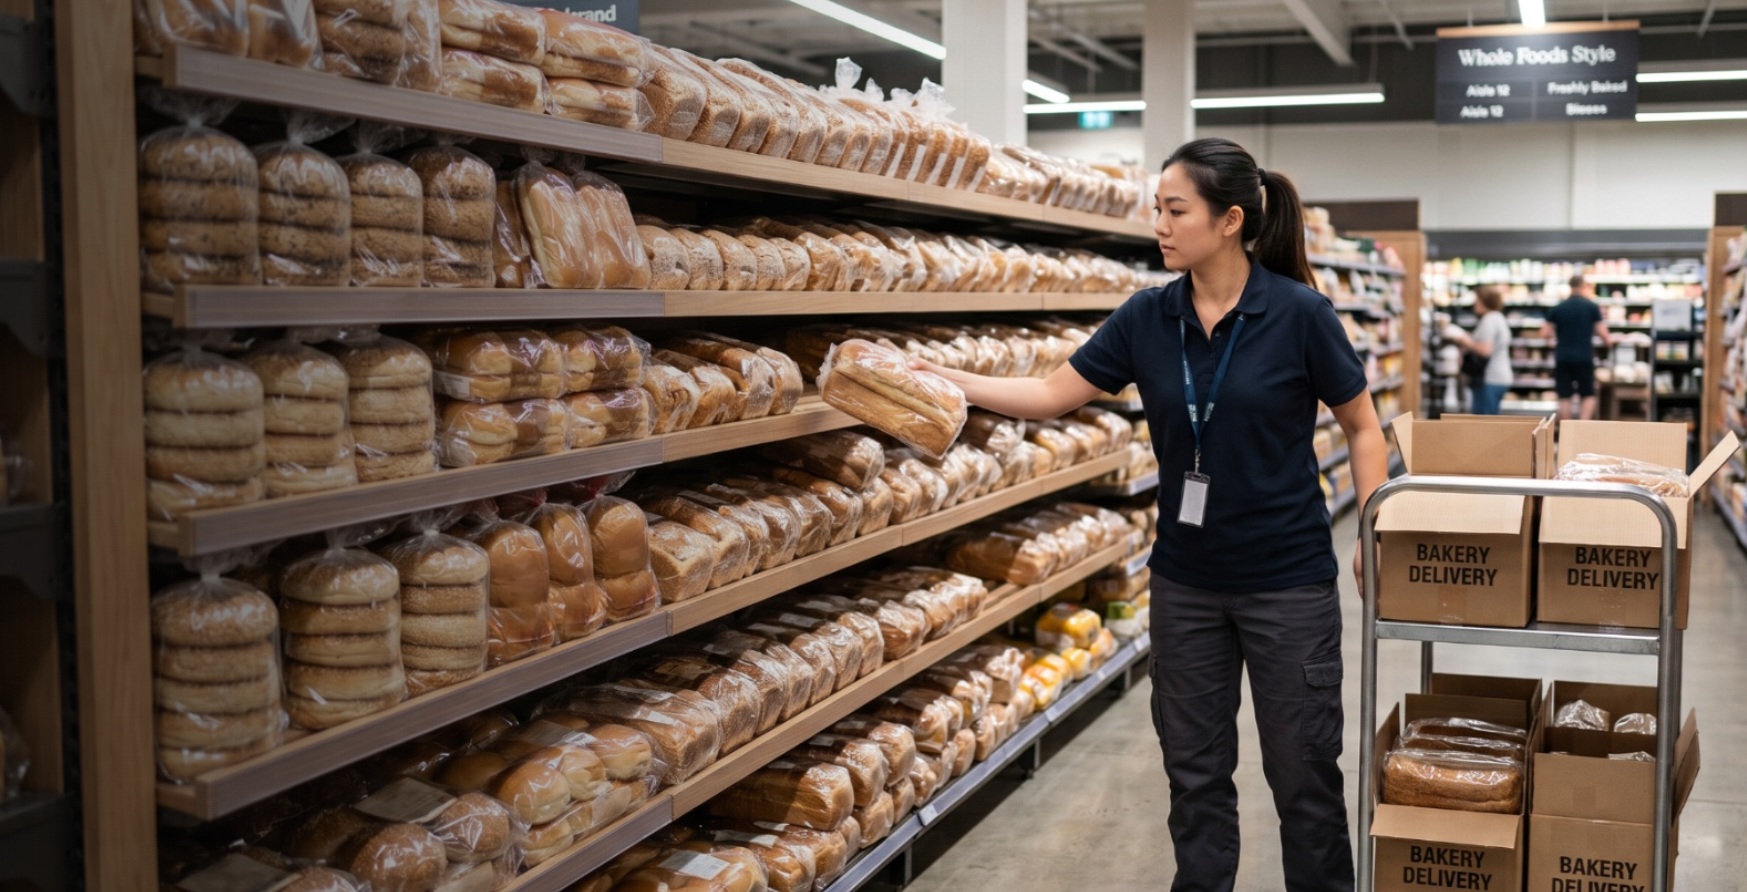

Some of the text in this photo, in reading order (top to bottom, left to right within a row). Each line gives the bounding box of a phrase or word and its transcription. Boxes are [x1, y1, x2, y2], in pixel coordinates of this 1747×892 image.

[1458, 44, 1616, 66] Whole Foods Style
[1547, 81, 1590, 95] Freshly
[1416, 543, 1491, 564] BAKERY
[1575, 547, 1651, 567] BAKERY
[1409, 565, 1498, 586] DELIVERY
[1567, 568, 1659, 590] DELIVERY
[1410, 845, 1485, 868] BAKERY
[1403, 866, 1492, 891] DELIVERY
[1559, 856, 1638, 880] BAKERY
